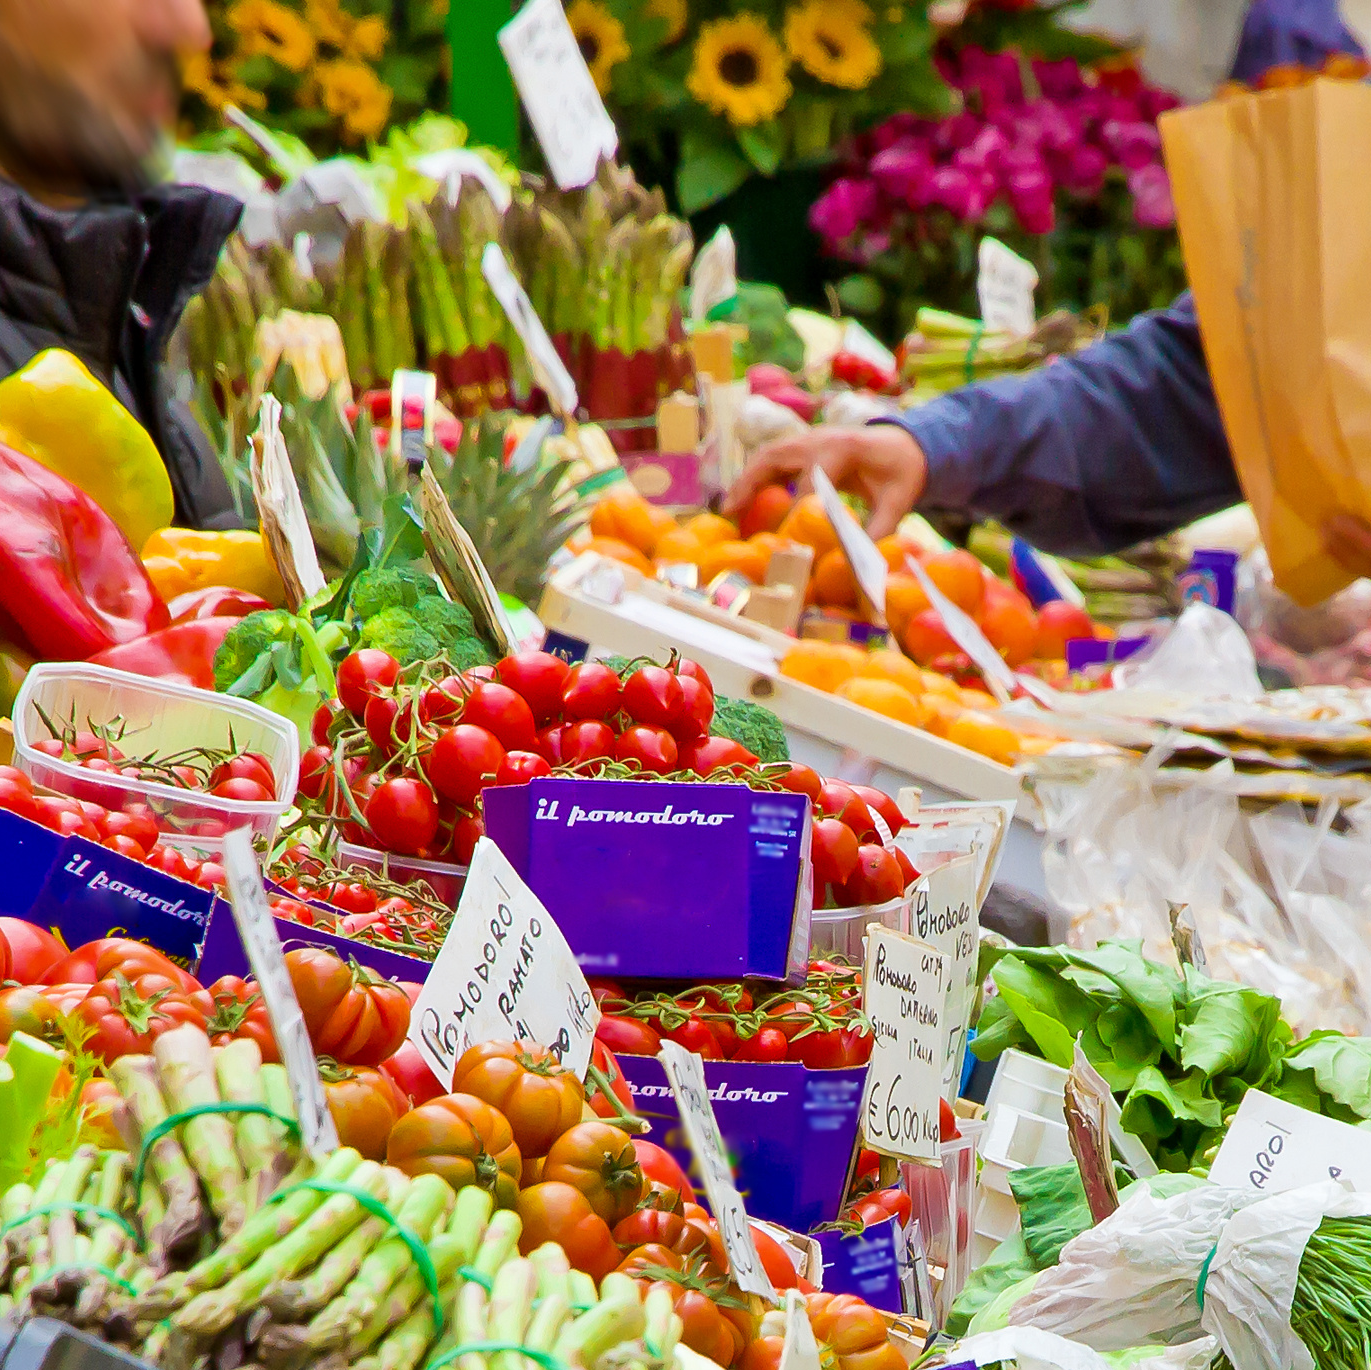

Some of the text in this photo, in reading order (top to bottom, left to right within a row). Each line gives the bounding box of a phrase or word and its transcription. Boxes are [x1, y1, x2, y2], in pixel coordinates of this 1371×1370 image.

[535, 798, 735, 827] il pomodoro
[64, 853, 92, 878] il
[421, 903, 512, 1073] POMODORO
[497, 917, 542, 1027] RAMATO
[873, 943, 918, 996] POMODORO
[908, 1037, 933, 1066] ITALIA
